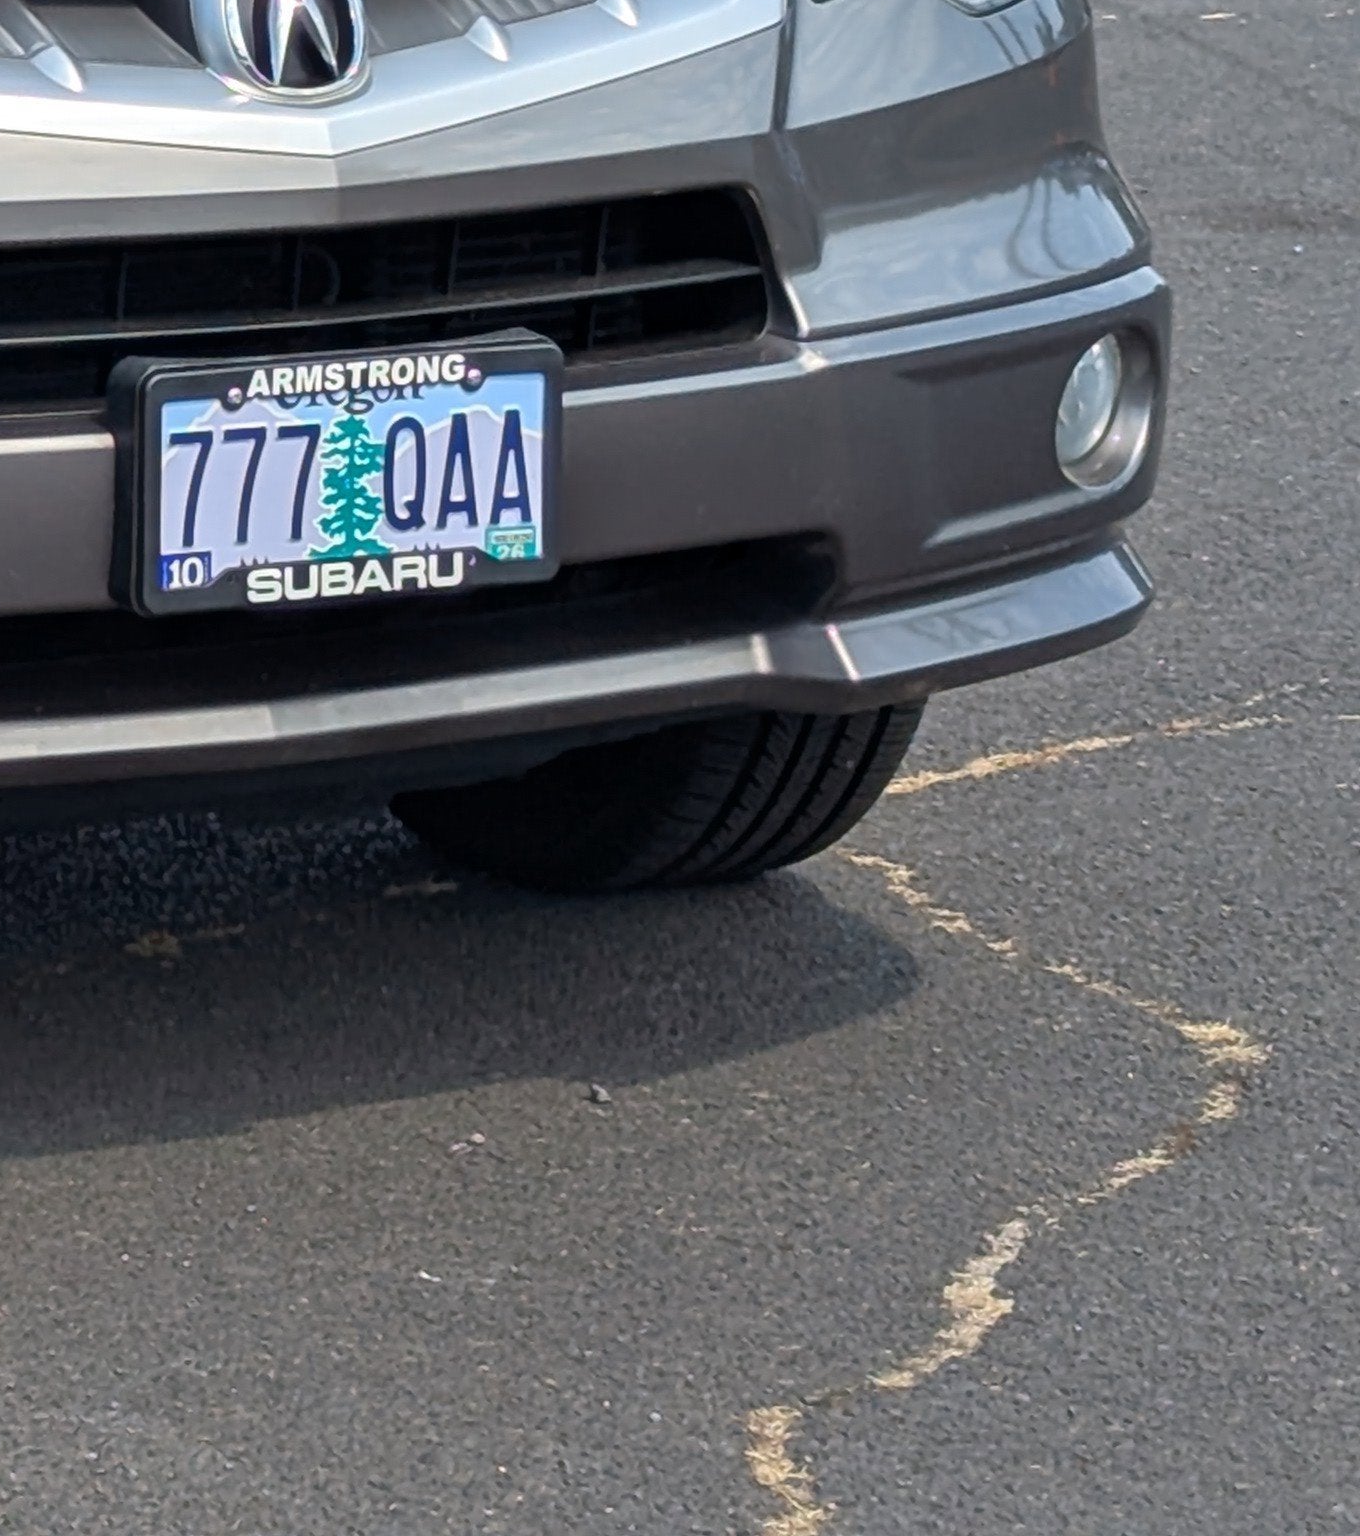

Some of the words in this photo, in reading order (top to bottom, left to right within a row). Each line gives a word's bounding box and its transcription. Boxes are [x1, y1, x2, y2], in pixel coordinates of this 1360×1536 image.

[246, 353, 466, 398] ARMSTRONG
[169, 423, 322, 548] 777
[383, 408, 533, 532] QAA
[168, 556, 205, 590] 10
[246, 551, 464, 604] SUBARU
